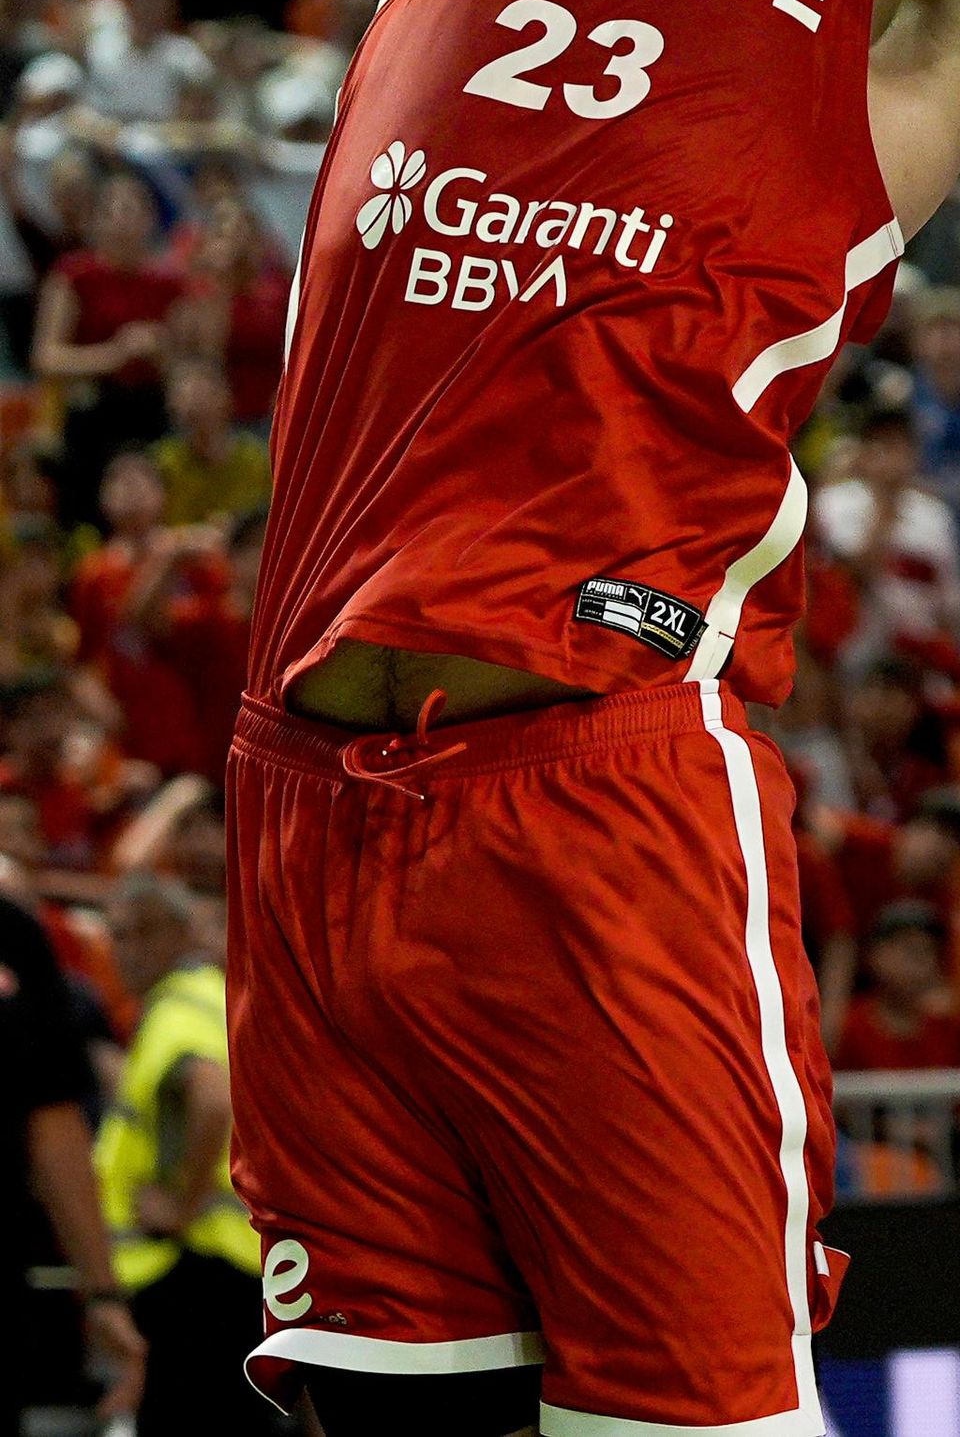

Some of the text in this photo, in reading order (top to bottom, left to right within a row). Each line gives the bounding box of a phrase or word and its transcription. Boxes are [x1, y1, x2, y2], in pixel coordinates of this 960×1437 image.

[423, 167, 674, 274] Garanti
[404, 247, 567, 313] BBVA
[587, 580, 625, 596] PUMA
[650, 600, 687, 637] 2XL
